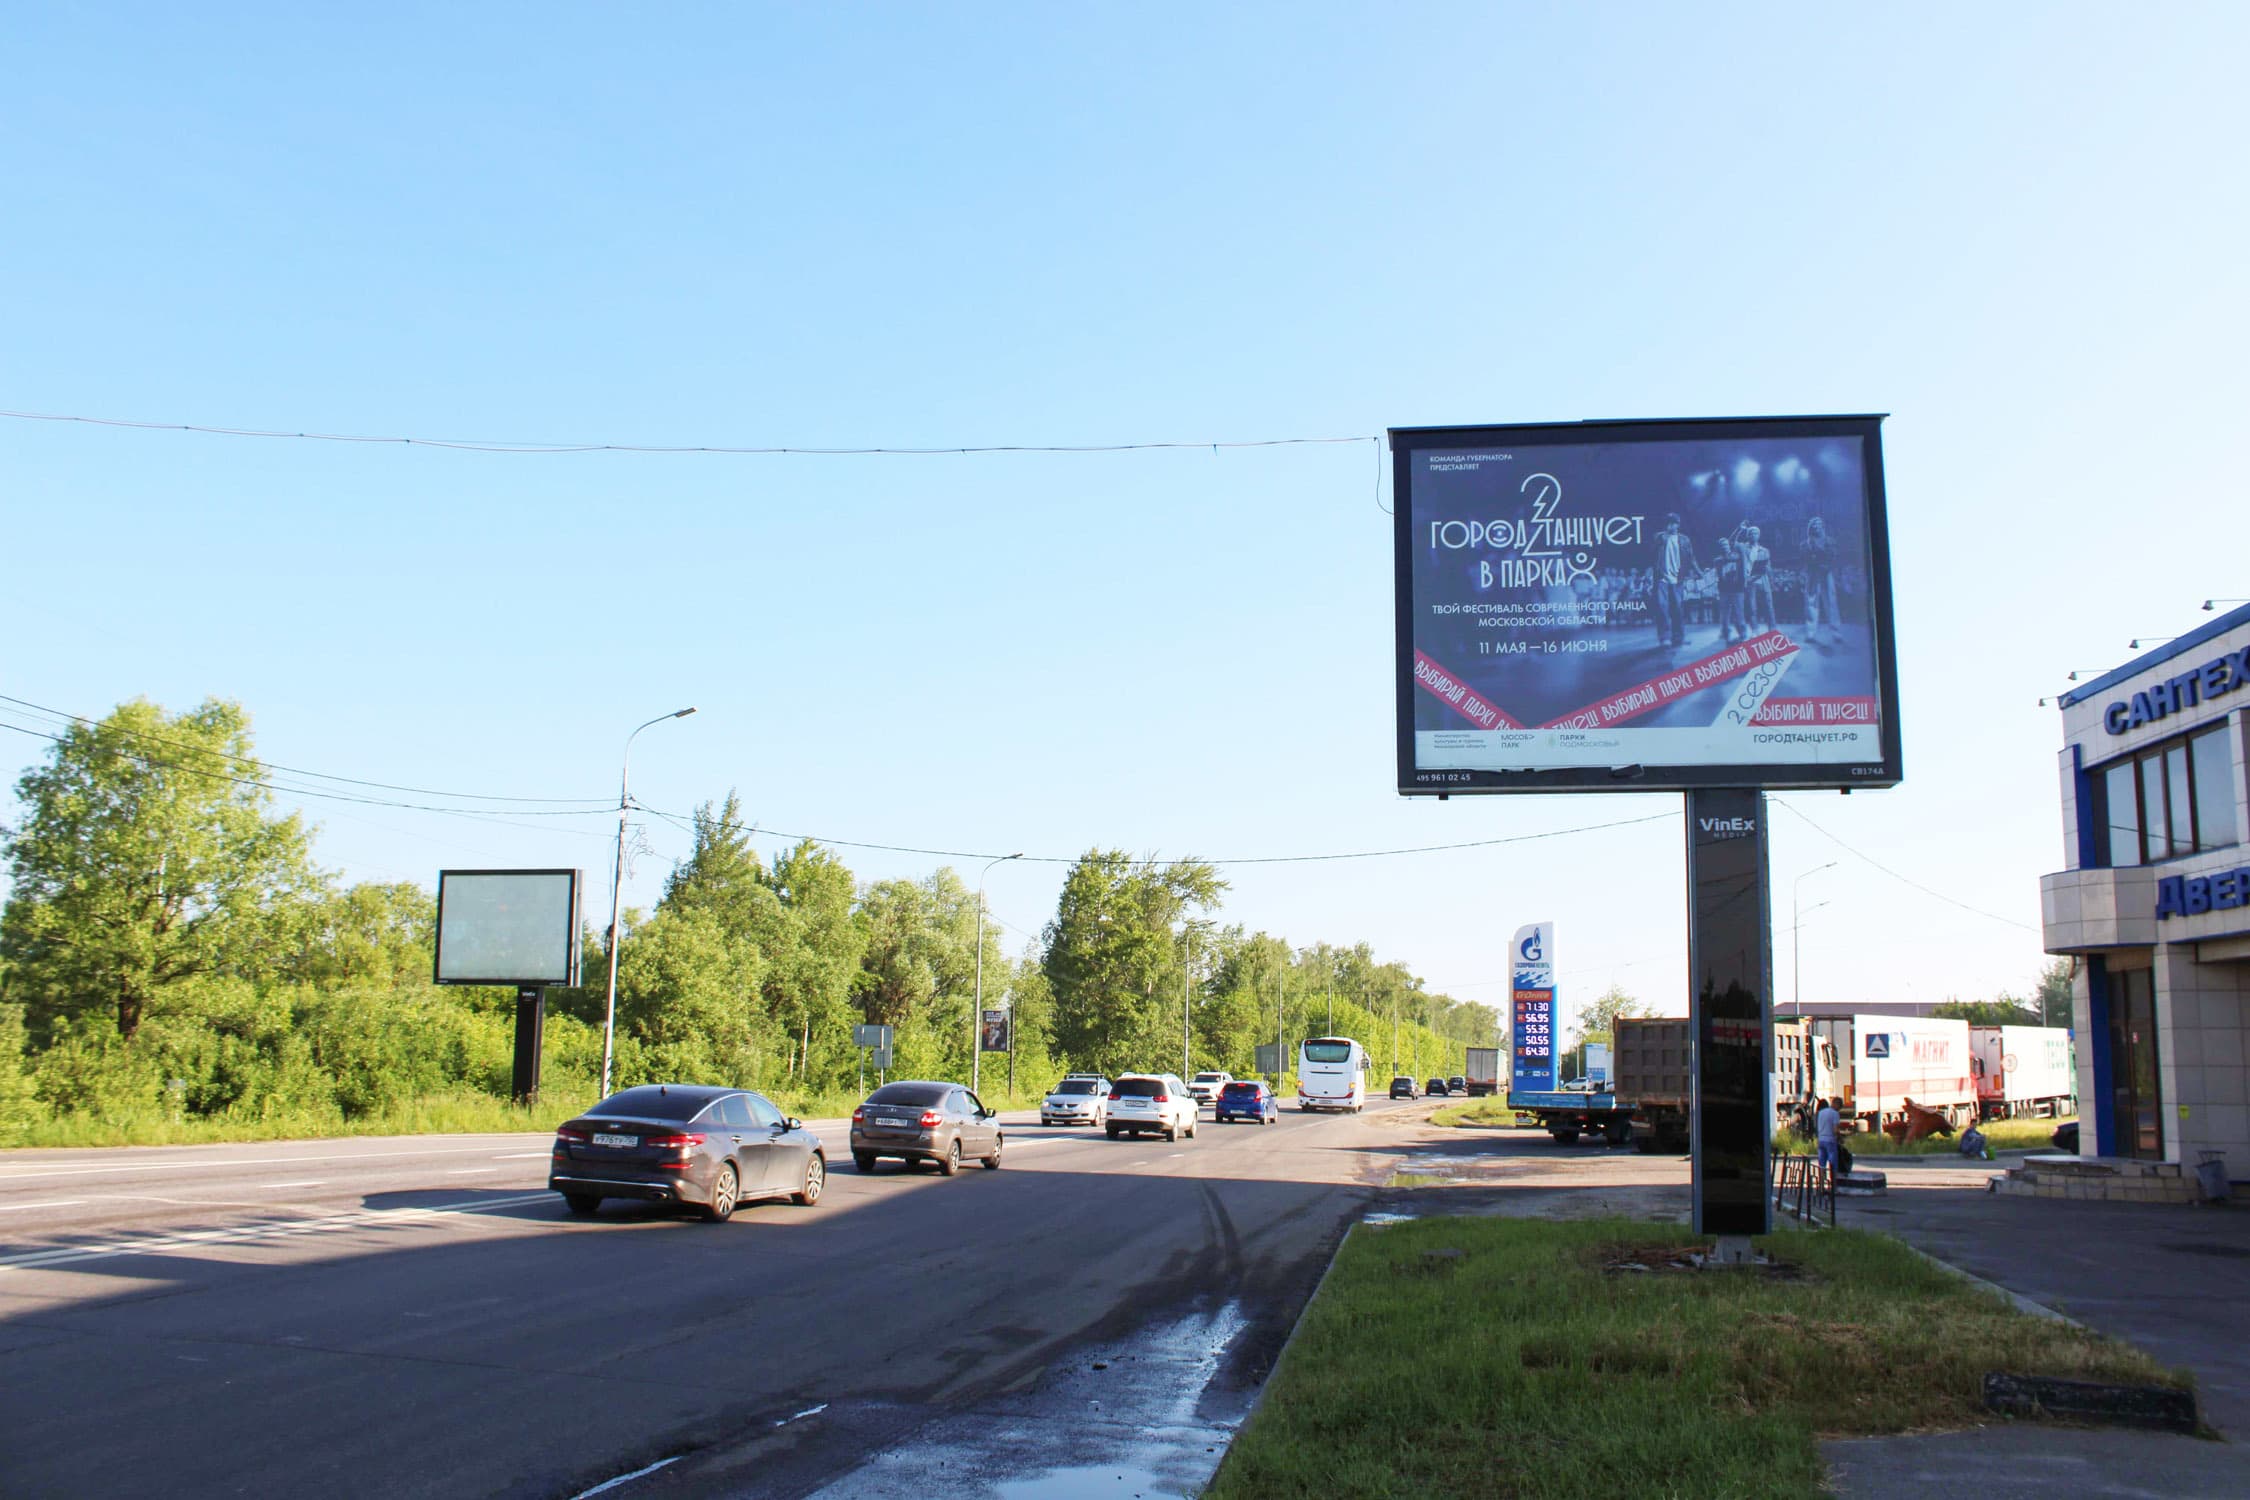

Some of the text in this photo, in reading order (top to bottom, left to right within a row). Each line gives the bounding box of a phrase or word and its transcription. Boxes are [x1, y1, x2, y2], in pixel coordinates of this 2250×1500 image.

[1429, 453, 1513, 463] КОМАНДА ГУБЕРНАТОРА
[1429, 463, 1480, 471] ПРЕДСТАВЛЯЕТ
[1480, 560, 1494, 588] В
[1432, 601, 1648, 614] ТВОЙ ФЕСТИВАЛЬ СОВРЕМЕННОГО ТАНЦА
[1478, 615, 1607, 627] МОСКОВСКОЙ ОБЛАСТИ
[1479, 642, 1490, 654] 11
[1496, 641, 1527, 654] МАЯ
[1561, 640, 1608, 653] ИЮНЯ
[1697, 646, 1752, 683] ВЫБИРАЙ
[1415, 660, 1497, 727] ВЫБИРАЙ ПАРК!
[1602, 673, 1694, 722] ВЫБИРАЙ ПАРК!
[1727, 709, 1744, 724] 2
[1755, 701, 1815, 721] ВЫБИРАЙ
[1753, 732, 1858, 743] ГОРОДТАНЦУЕТ.РФ
[1416, 775, 1430, 783] 495
[1431, 774, 1446, 782] 961
[1461, 773, 1471, 781] 45
[1700, 818, 1755, 831] VinEx
[1525, 1013, 1549, 1022] 56.95
[1525, 1024, 1549, 1034] 55.35
[1525, 1035, 1549, 1045] 50.55
[1525, 1046, 1549, 1056] 64.30
